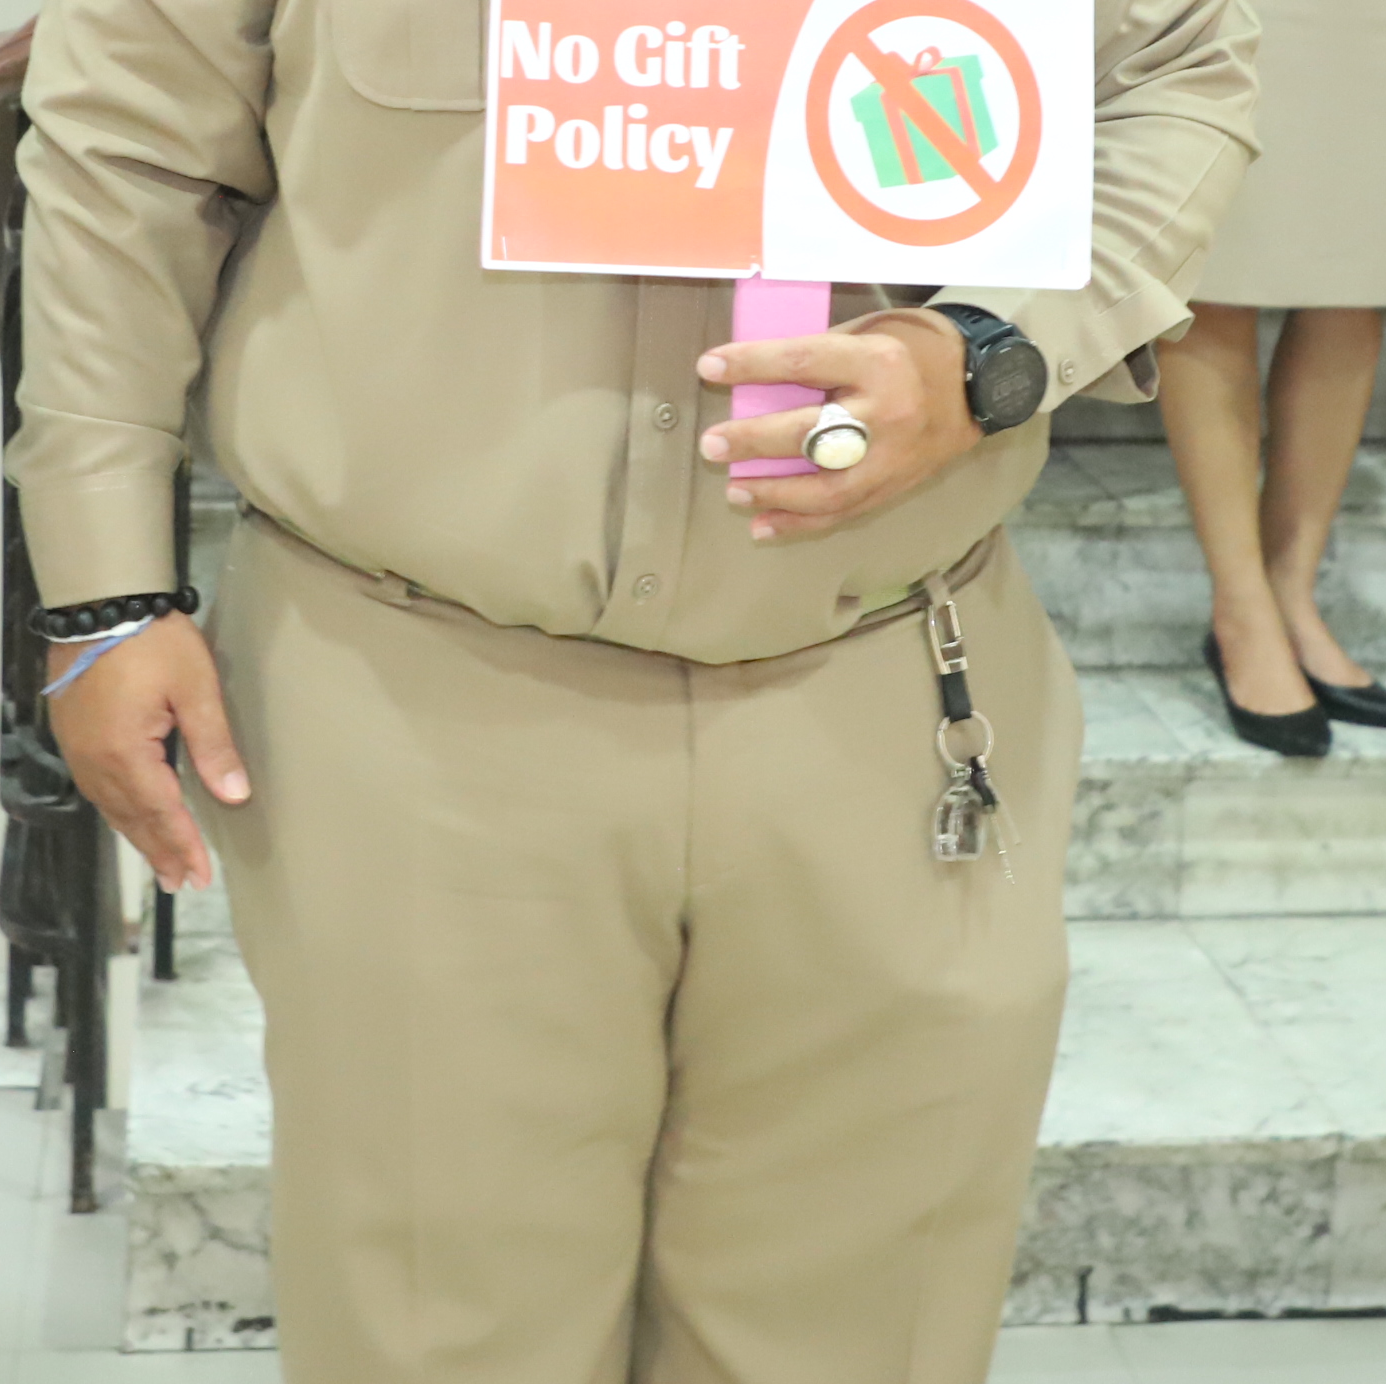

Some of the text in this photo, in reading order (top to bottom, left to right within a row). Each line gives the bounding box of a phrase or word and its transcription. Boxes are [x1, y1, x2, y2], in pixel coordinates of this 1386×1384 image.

[501, 20, 747, 91] No Gift
[504, 103, 735, 190] Policy
